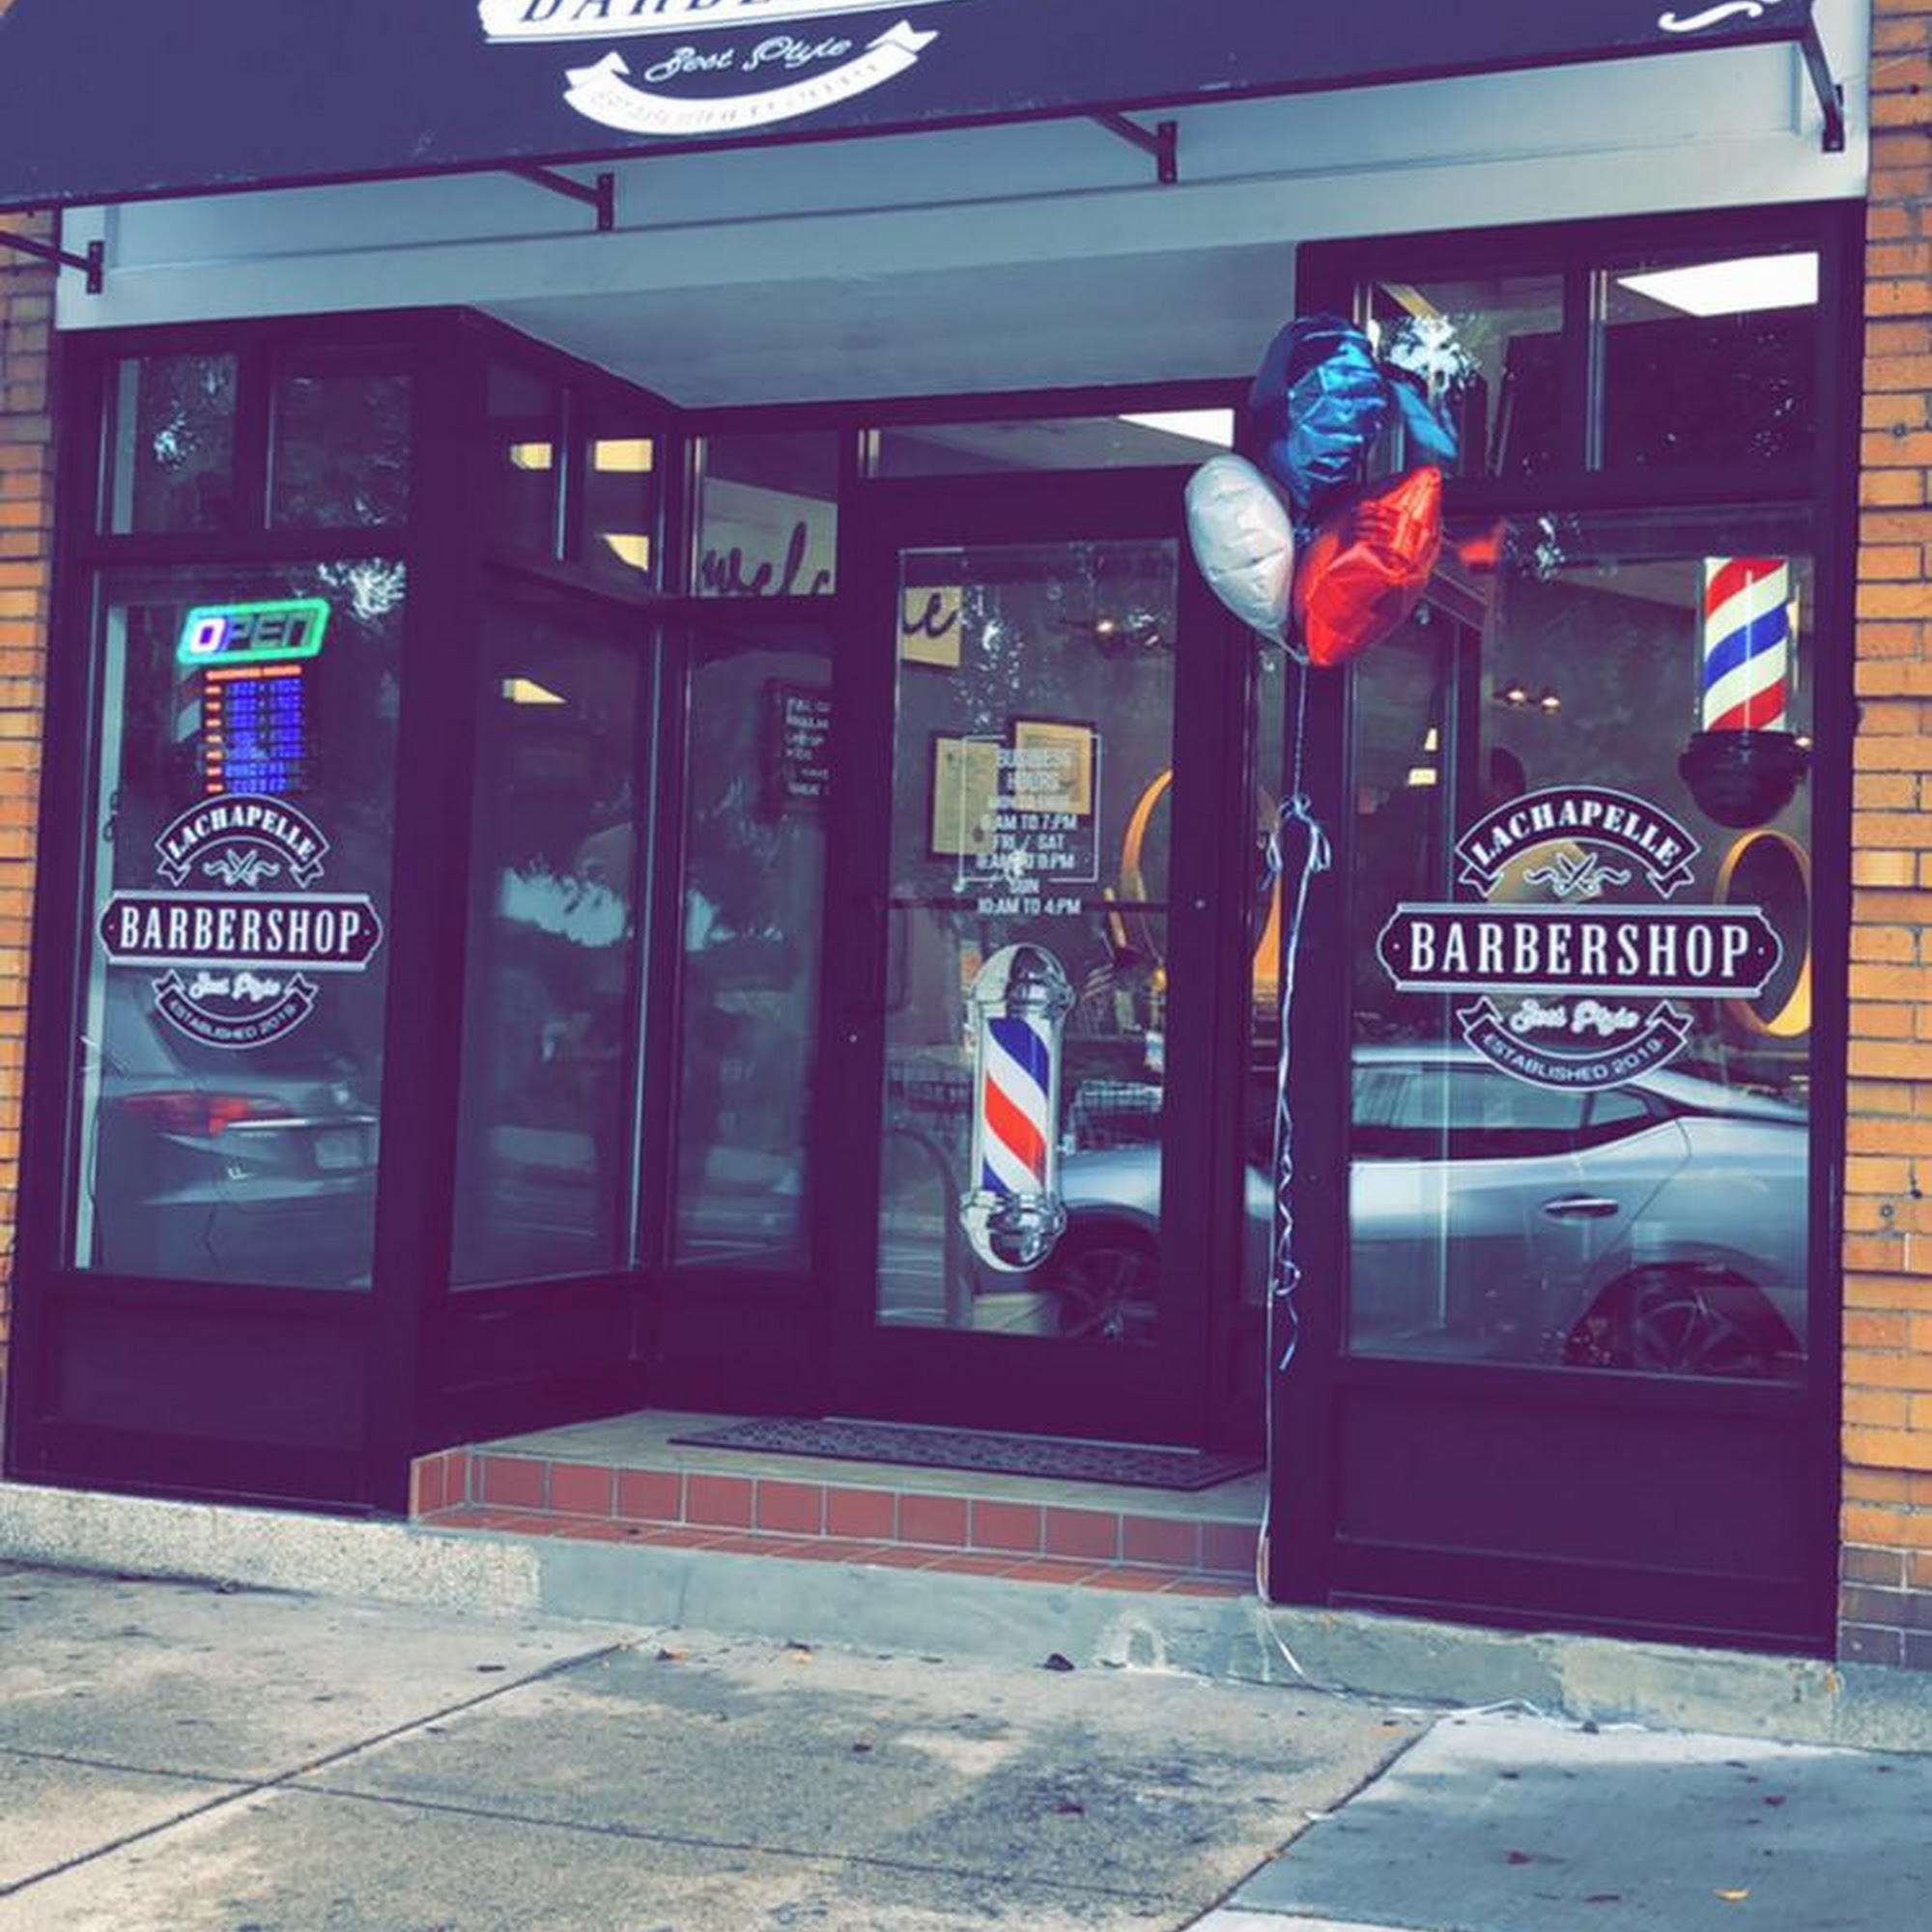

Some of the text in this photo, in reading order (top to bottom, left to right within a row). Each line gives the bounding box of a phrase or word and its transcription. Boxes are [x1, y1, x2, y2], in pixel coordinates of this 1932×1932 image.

[189, 611, 314, 654] OPEN
[167, 806, 317, 861] LACHAPELLE
[1471, 800, 1683, 867] LACHAPELLE
[120, 905, 360, 953] BARBERSHOP
[1409, 921, 1749, 978] BARBERSHOP
[1484, 1034, 1662, 1081] ESTABLISHED 2019
